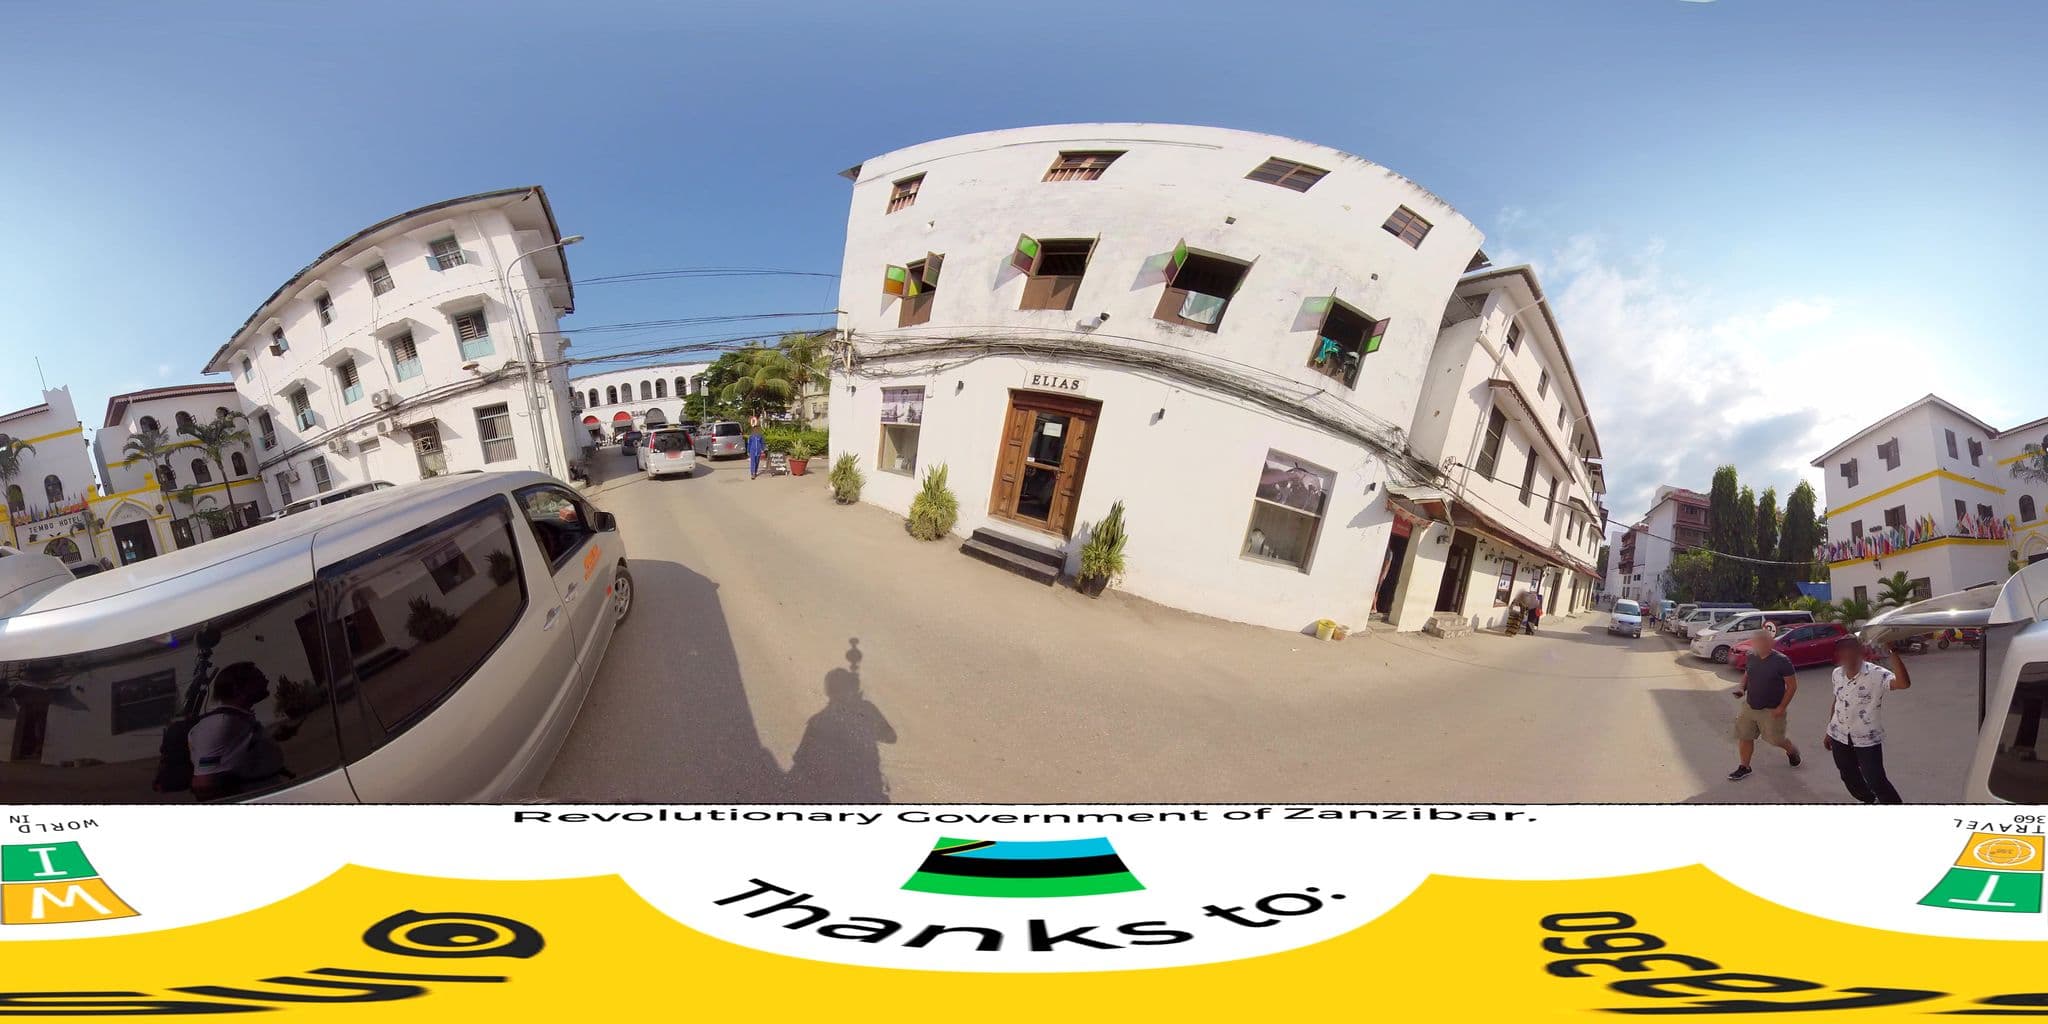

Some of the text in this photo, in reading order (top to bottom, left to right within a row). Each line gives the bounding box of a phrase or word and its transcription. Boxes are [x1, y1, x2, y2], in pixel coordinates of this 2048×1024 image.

[1032, 374, 1080, 390] ELIAS
[28, 516, 81, 534] TEMBO HOTEL
